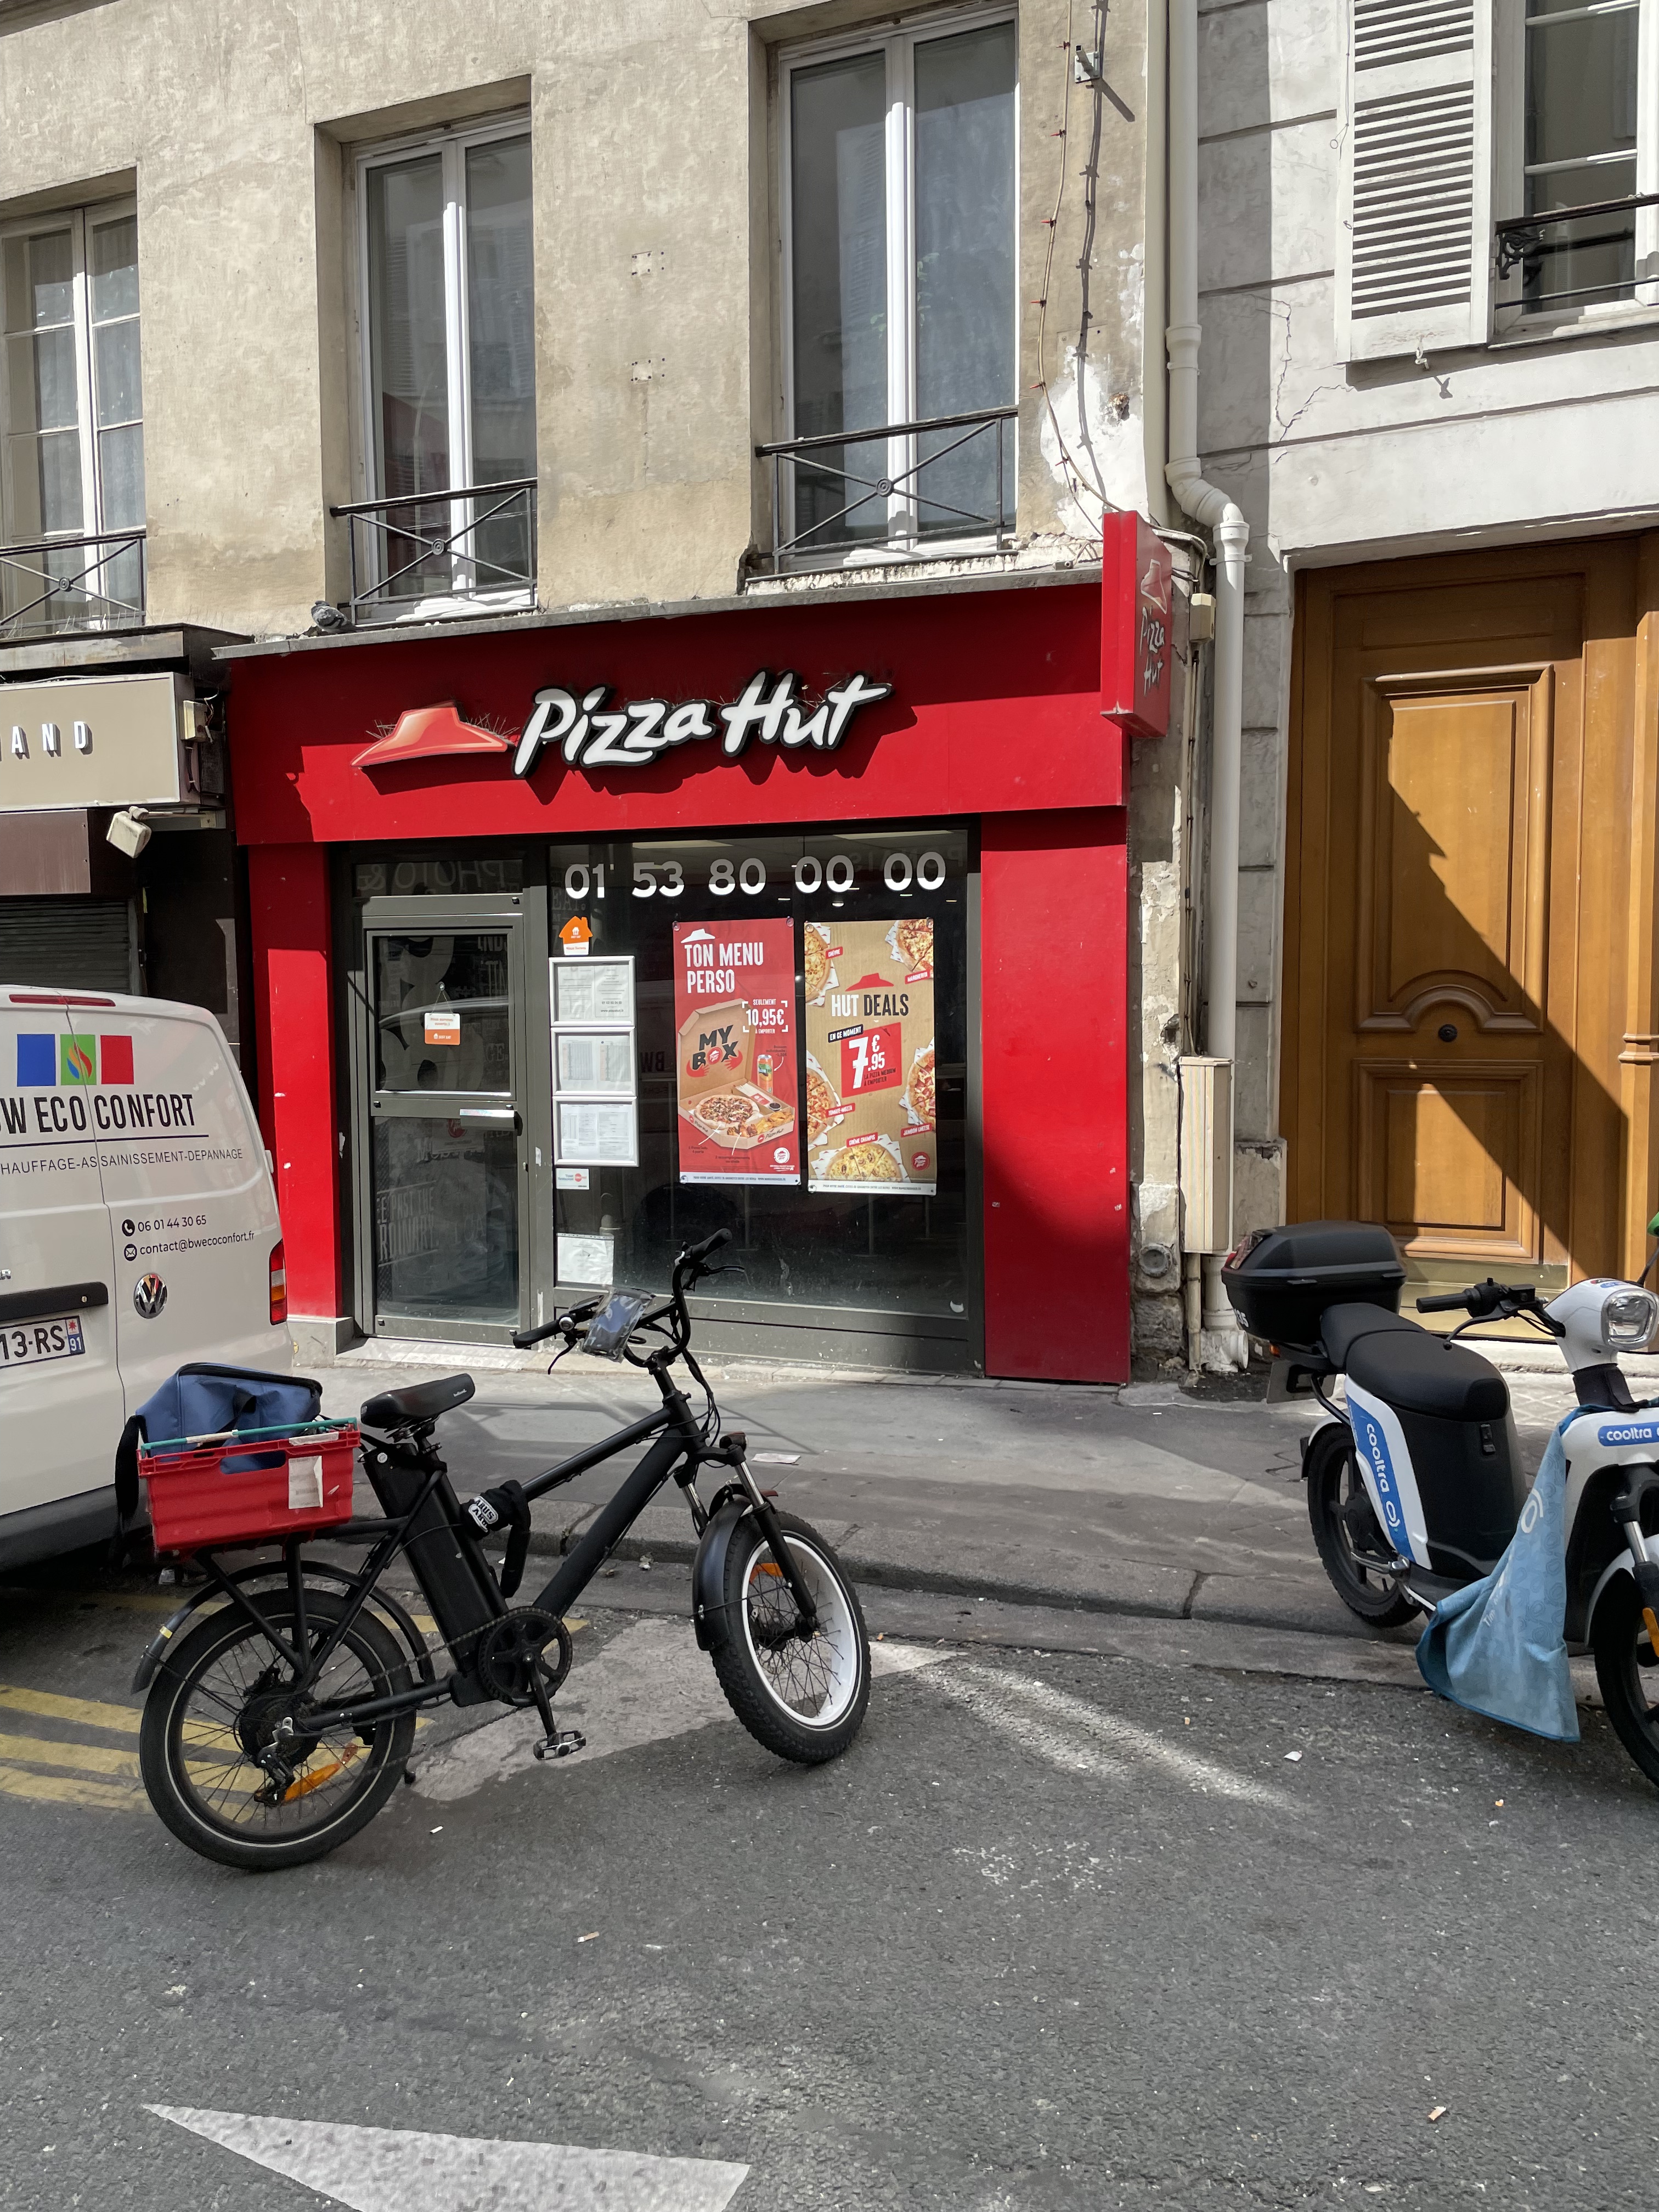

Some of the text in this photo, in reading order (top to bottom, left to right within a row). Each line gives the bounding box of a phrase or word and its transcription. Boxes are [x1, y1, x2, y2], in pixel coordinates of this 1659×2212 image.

[1139, 606, 1165, 656] Pizza
[1143, 655, 1163, 696] Hut
[512, 668, 893, 777] Pizza Hut
[565, 864, 605, 899] 01
[631, 860, 685, 898] 53
[708, 857, 767, 896] 80
[794, 855, 854, 894] 00
[883, 851, 946, 891] 00
[685, 942, 763, 967] TON MENU
[687, 969, 735, 994] PERSO
[746, 1008, 785, 1028] 10,95€
[831, 994, 909, 1017] HUT DEALS
[699, 1025, 733, 1051] MY
[830, 1032, 836, 1041] EN
[843, 1026, 862, 1037] MOMENT
[849, 1036, 868, 1089] 7
[0, 1094, 195, 1134] W ECO CONFORT
[138, 1215, 206, 1232] 06 01 44 30 65
[140, 1231, 254, 1255] contact@bwecoconfort.fr
[70, 1336, 82, 1351] 91
[1606, 1426, 1652, 1441] cooltra
[1367, 1423, 1390, 1493] cooltra
